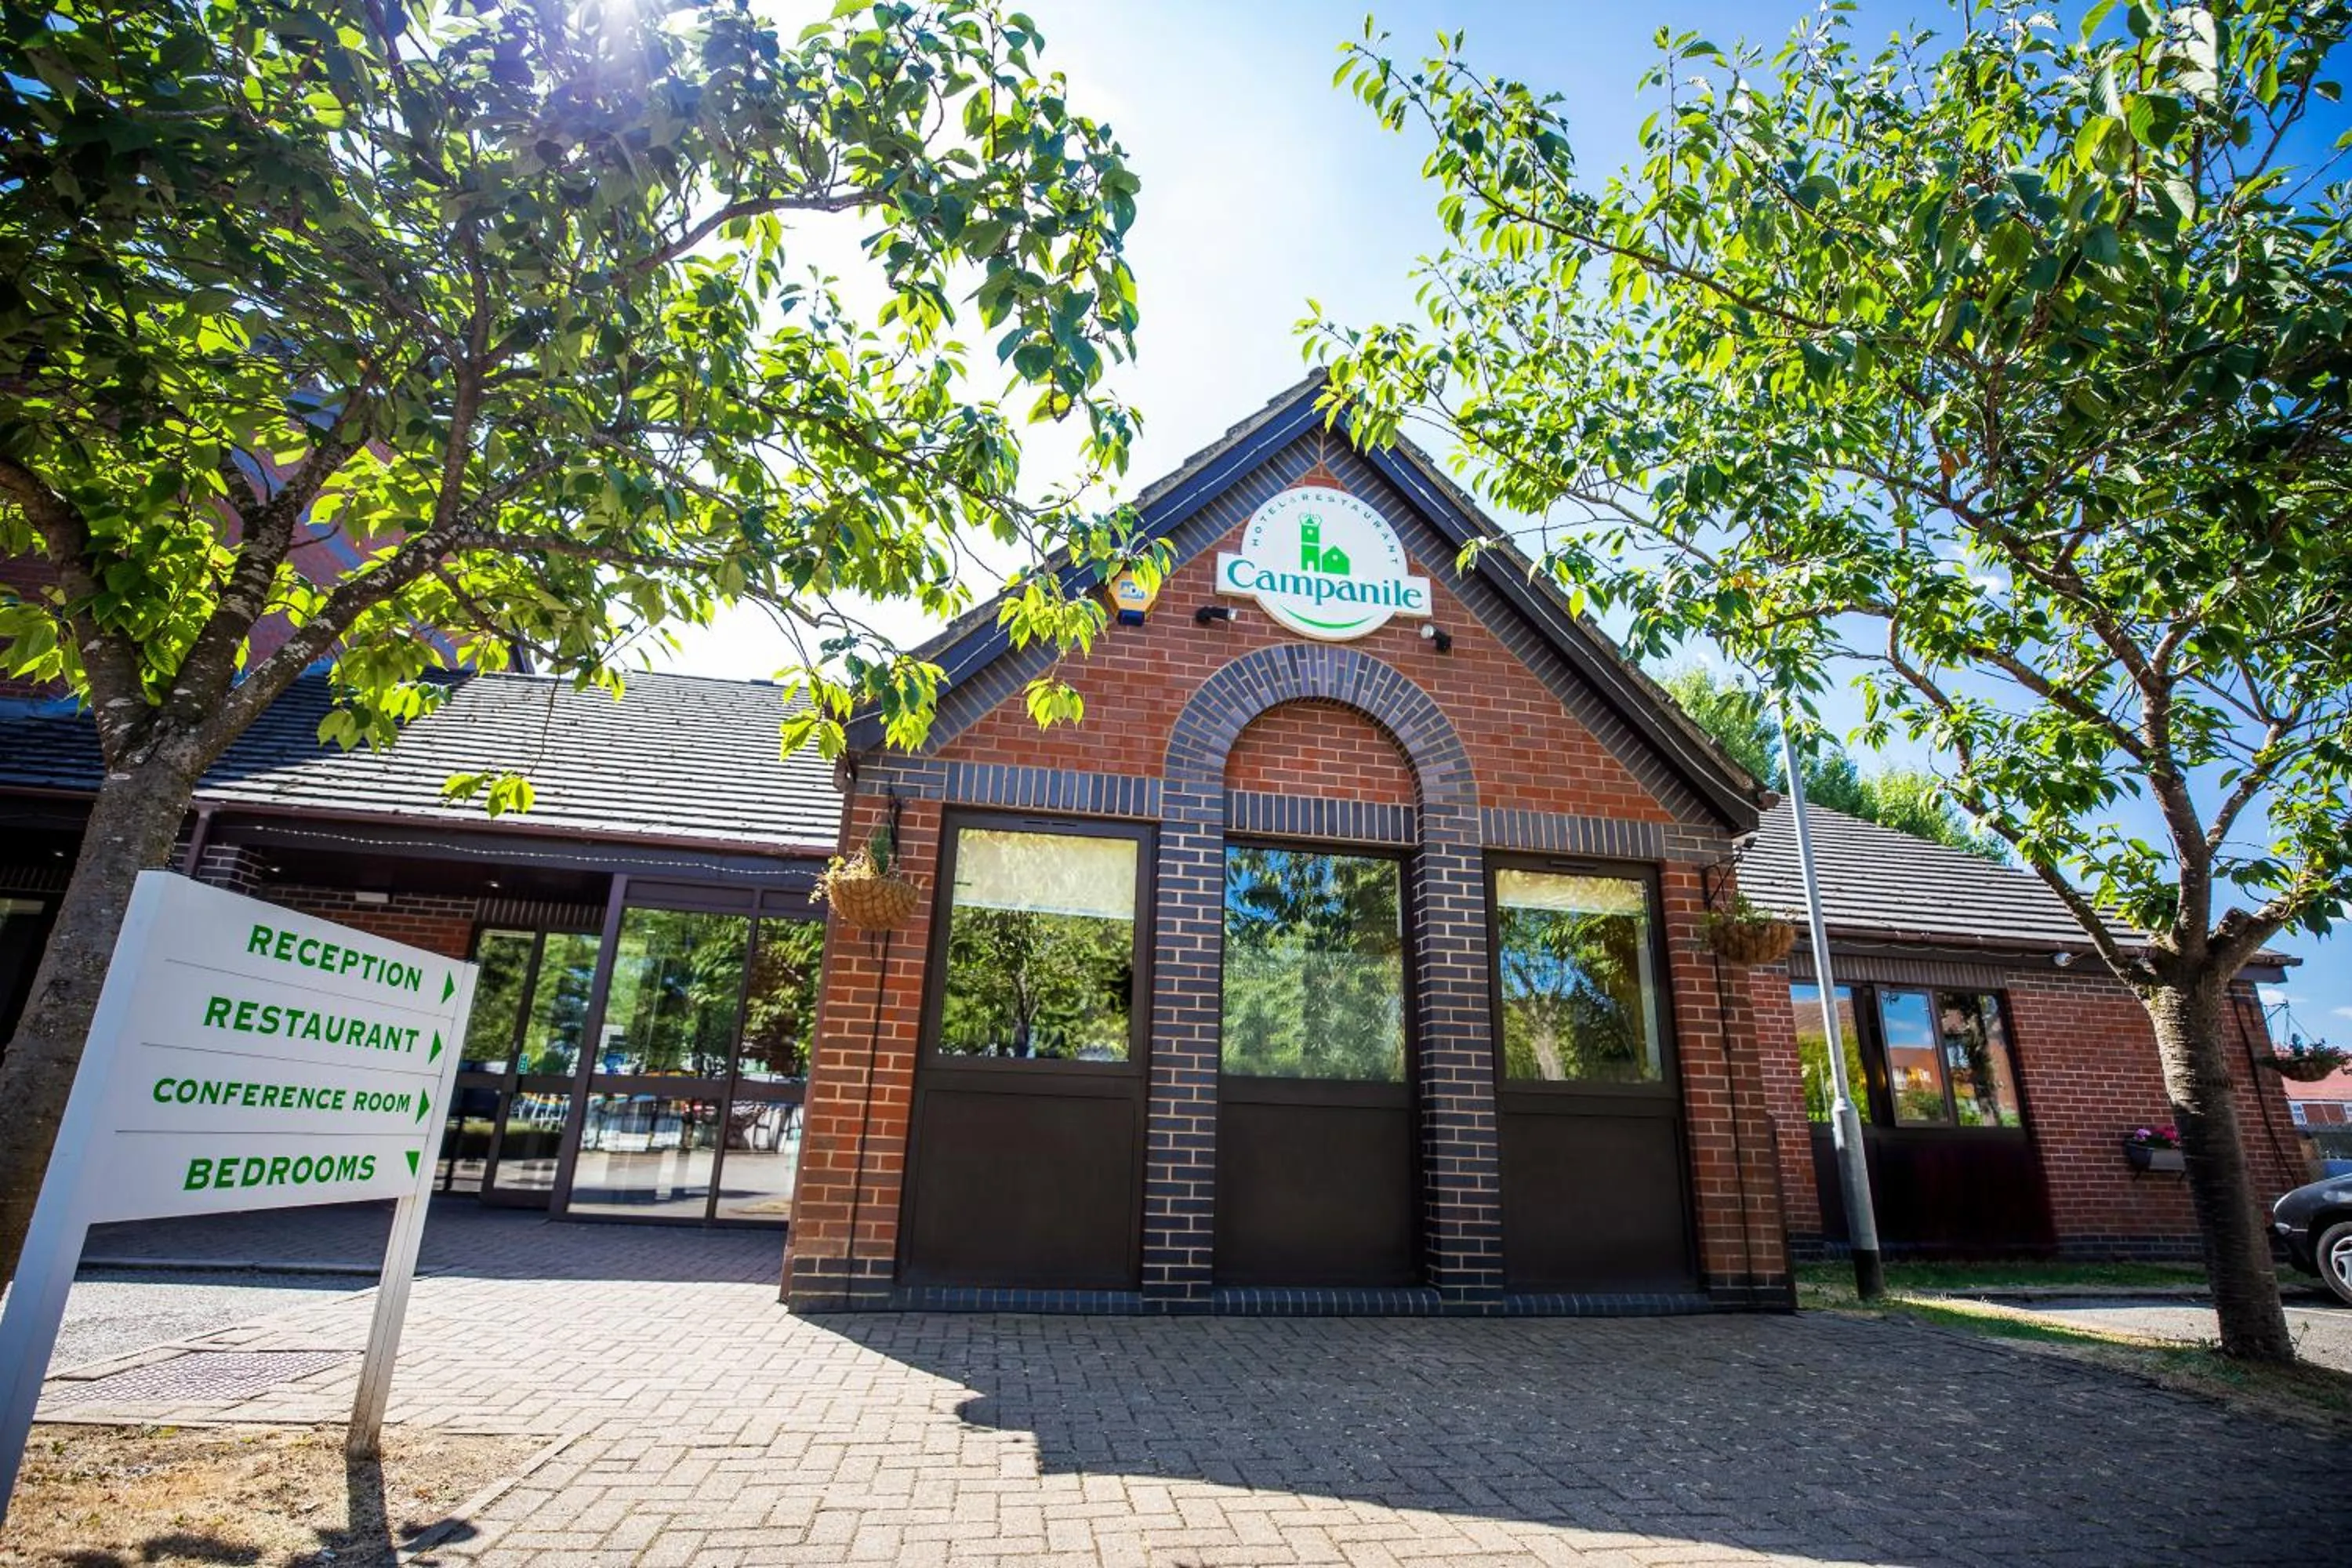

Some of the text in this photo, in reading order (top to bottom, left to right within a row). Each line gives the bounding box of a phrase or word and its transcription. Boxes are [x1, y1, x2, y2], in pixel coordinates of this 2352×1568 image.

[1252, 493, 1399, 564] HOTEL RESTAURANT
[1226, 558, 1423, 609] Campanile
[248, 924, 423, 992] RECEPTION
[202, 996, 419, 1053] RESTAURANT
[152, 1078, 411, 1112] CONFERENCE ROOM
[183, 1155, 376, 1191] BEDROOMS
